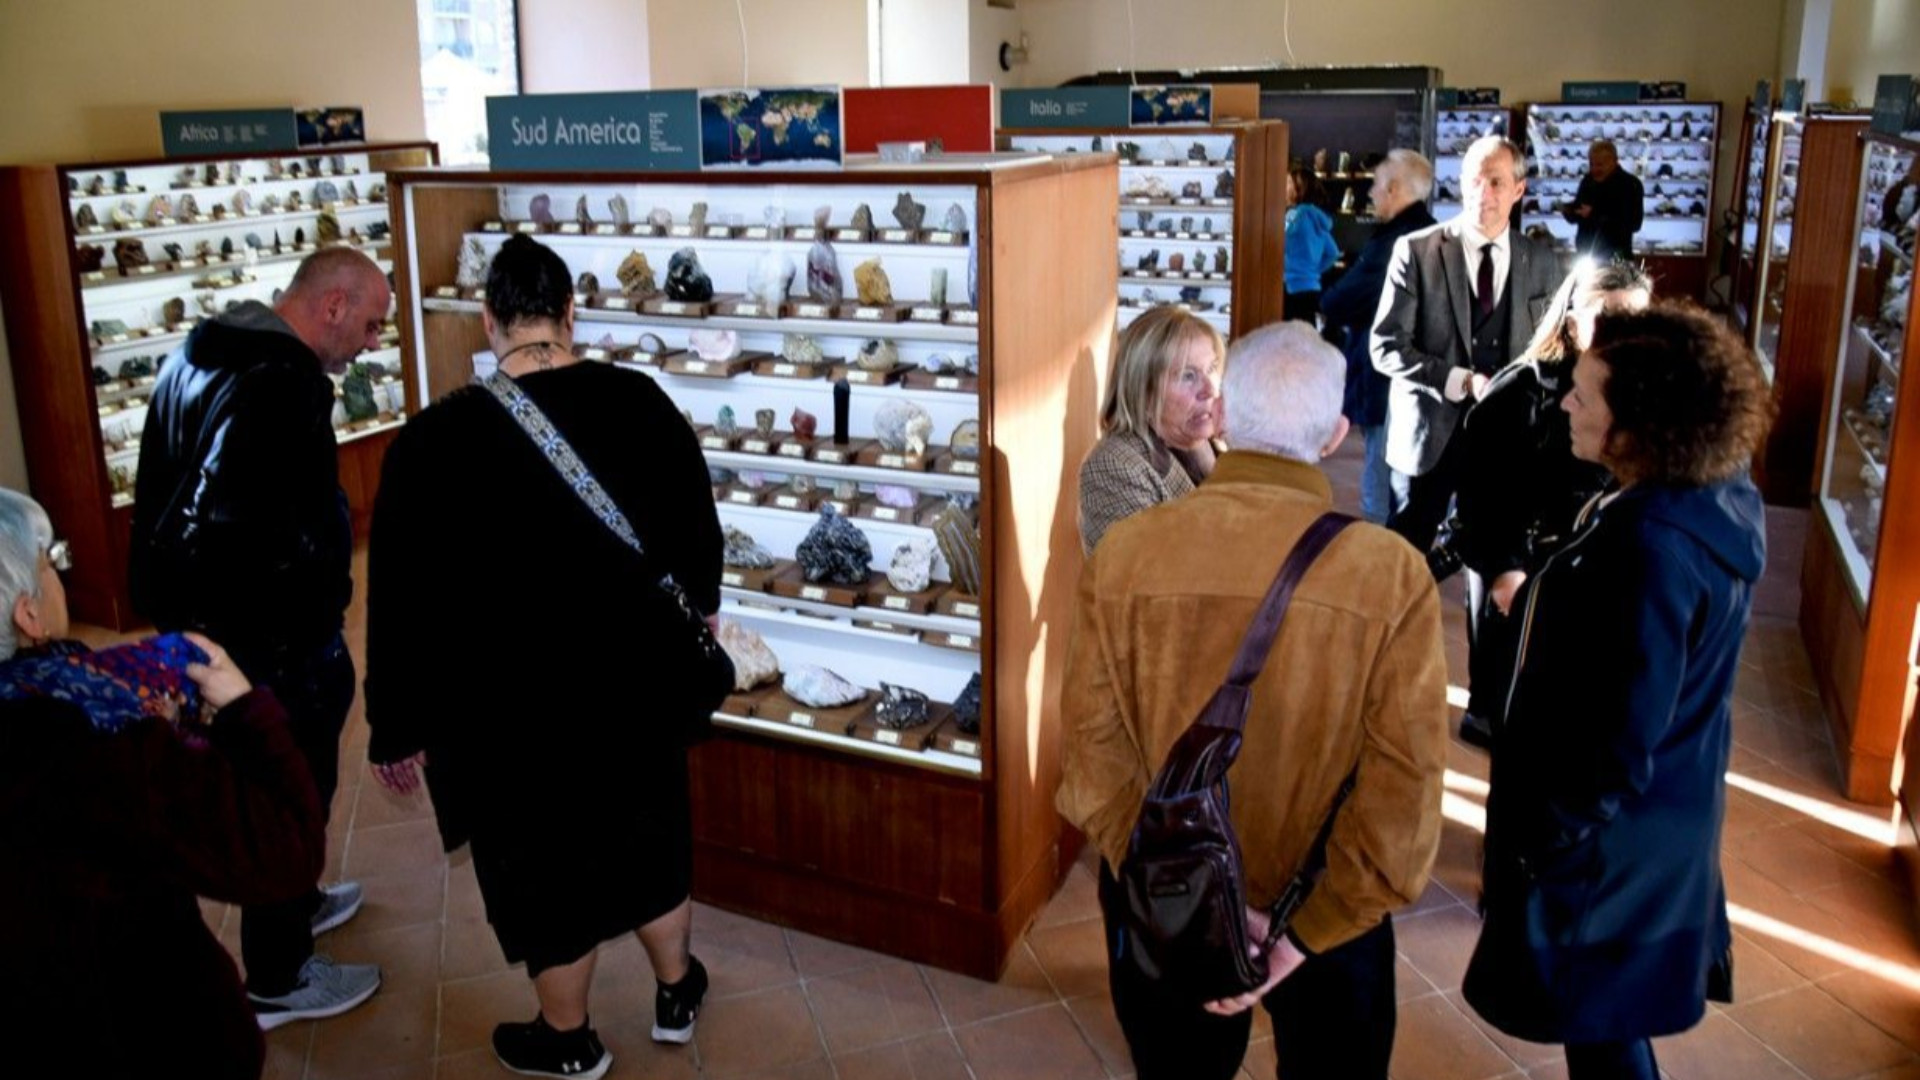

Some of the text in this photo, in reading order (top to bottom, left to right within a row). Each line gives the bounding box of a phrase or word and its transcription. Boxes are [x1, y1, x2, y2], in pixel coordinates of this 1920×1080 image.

[1029, 99, 1061, 116] Italia
[181, 123, 219, 142] Africa
[511, 116, 547, 146] Sud
[555, 116, 641, 145] America
